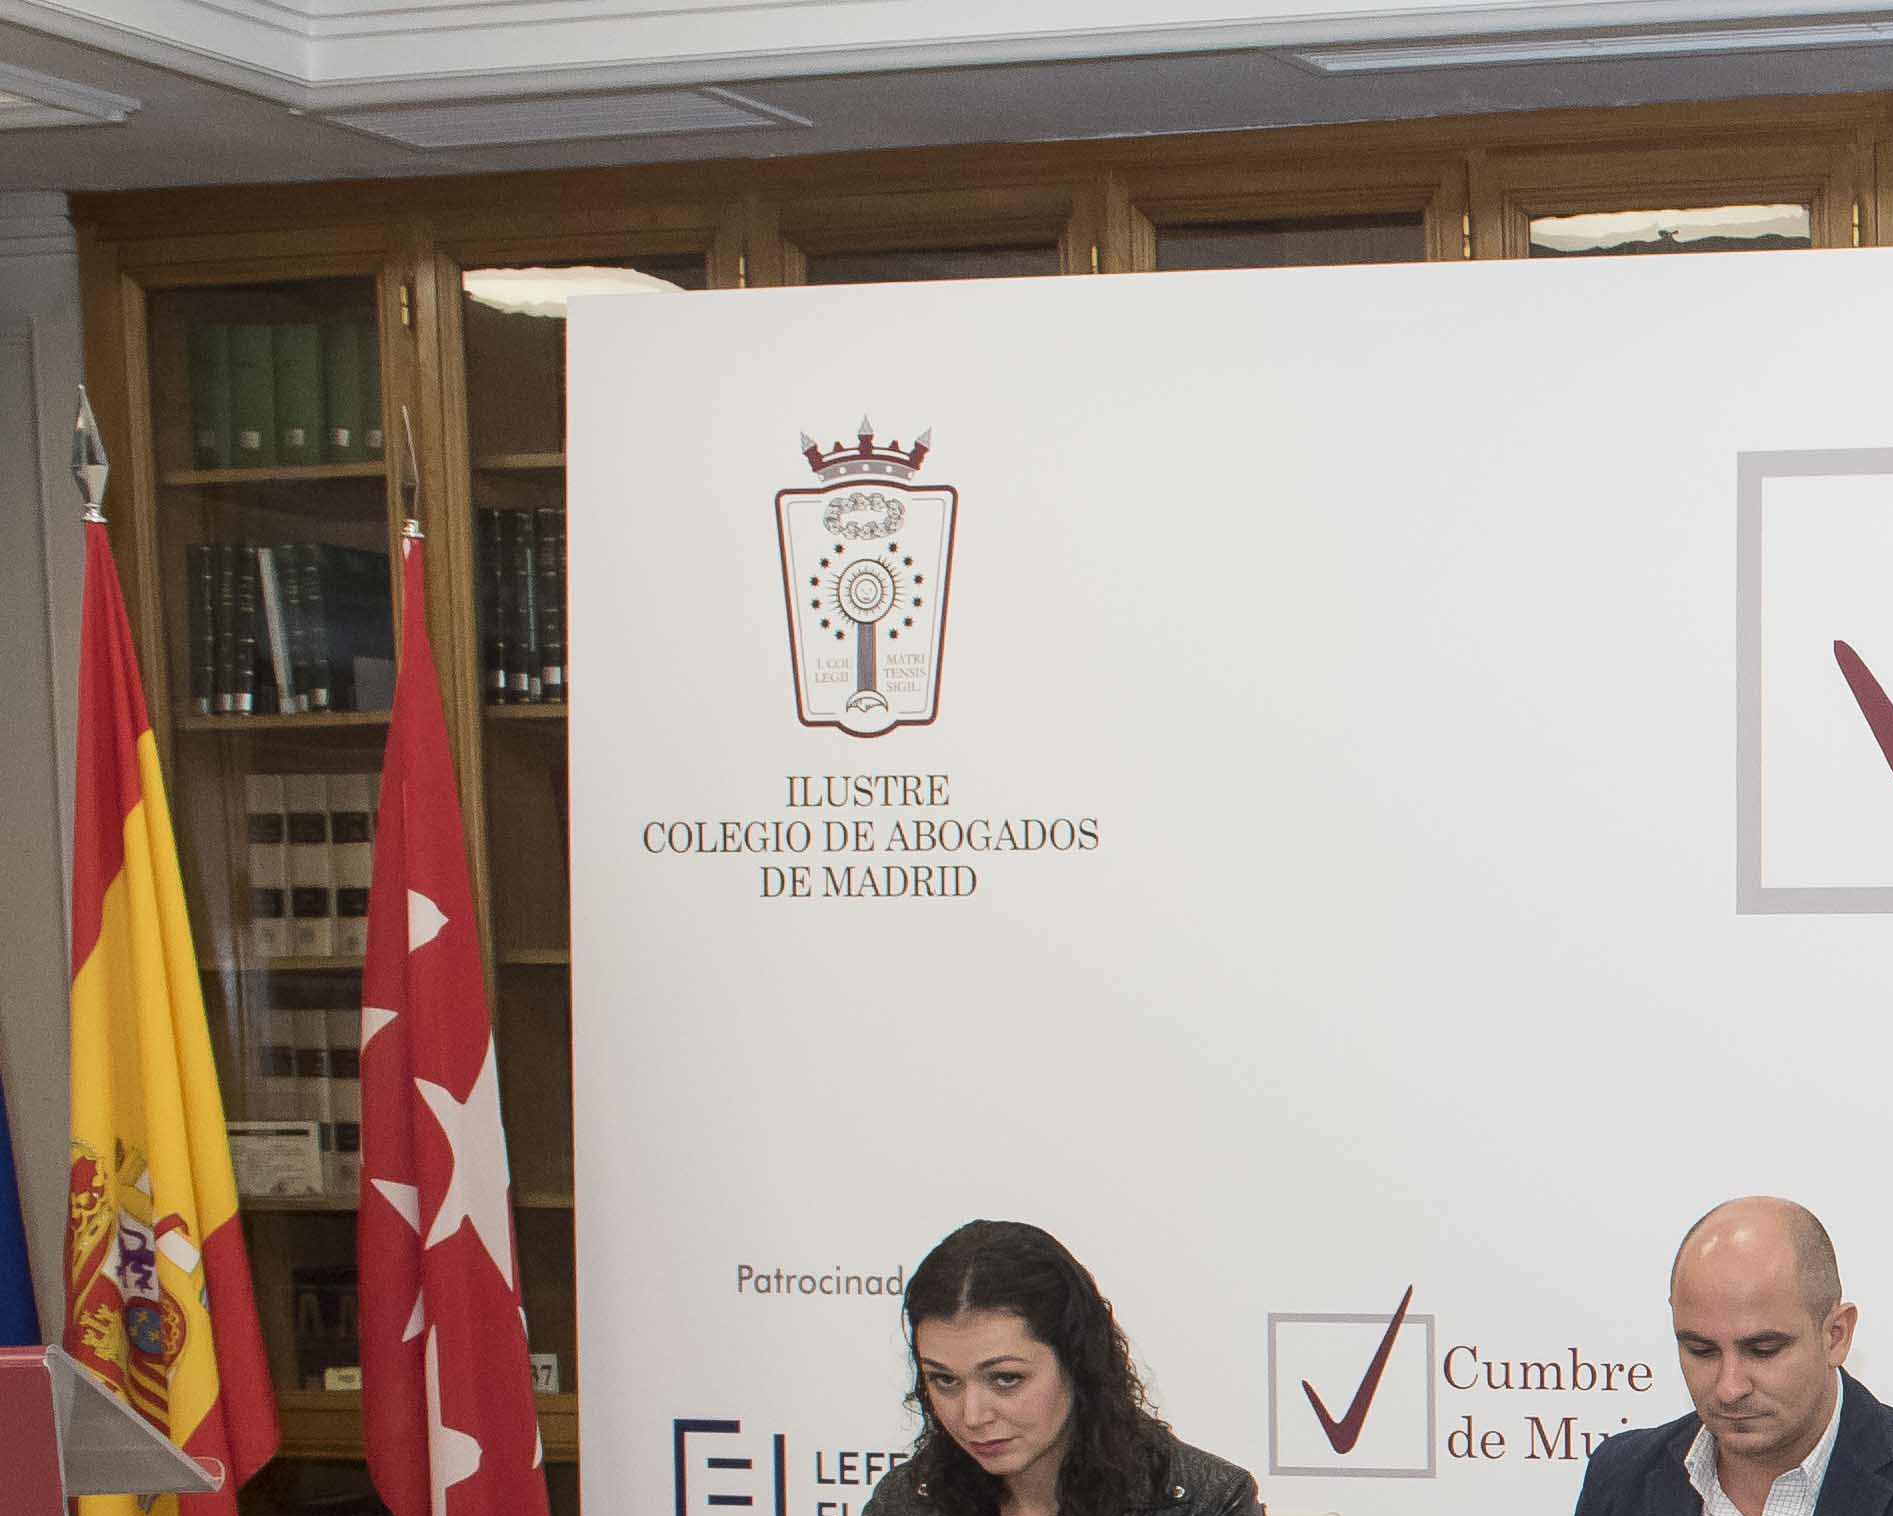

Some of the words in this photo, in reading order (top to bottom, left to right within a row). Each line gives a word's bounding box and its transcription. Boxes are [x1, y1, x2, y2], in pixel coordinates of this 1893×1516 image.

[787, 775, 949, 807] ILUSTRE
[643, 821, 811, 853] COLEGIO
[824, 821, 874, 851] DE
[886, 819, 1098, 851] ABOGADOS
[761, 867, 811, 897] DE
[823, 866, 976, 897] MADRID
[737, 1264, 903, 1297] Patrocinad
[1444, 1346, 1652, 1391] Cumbre
[1448, 1416, 1505, 1459] de
